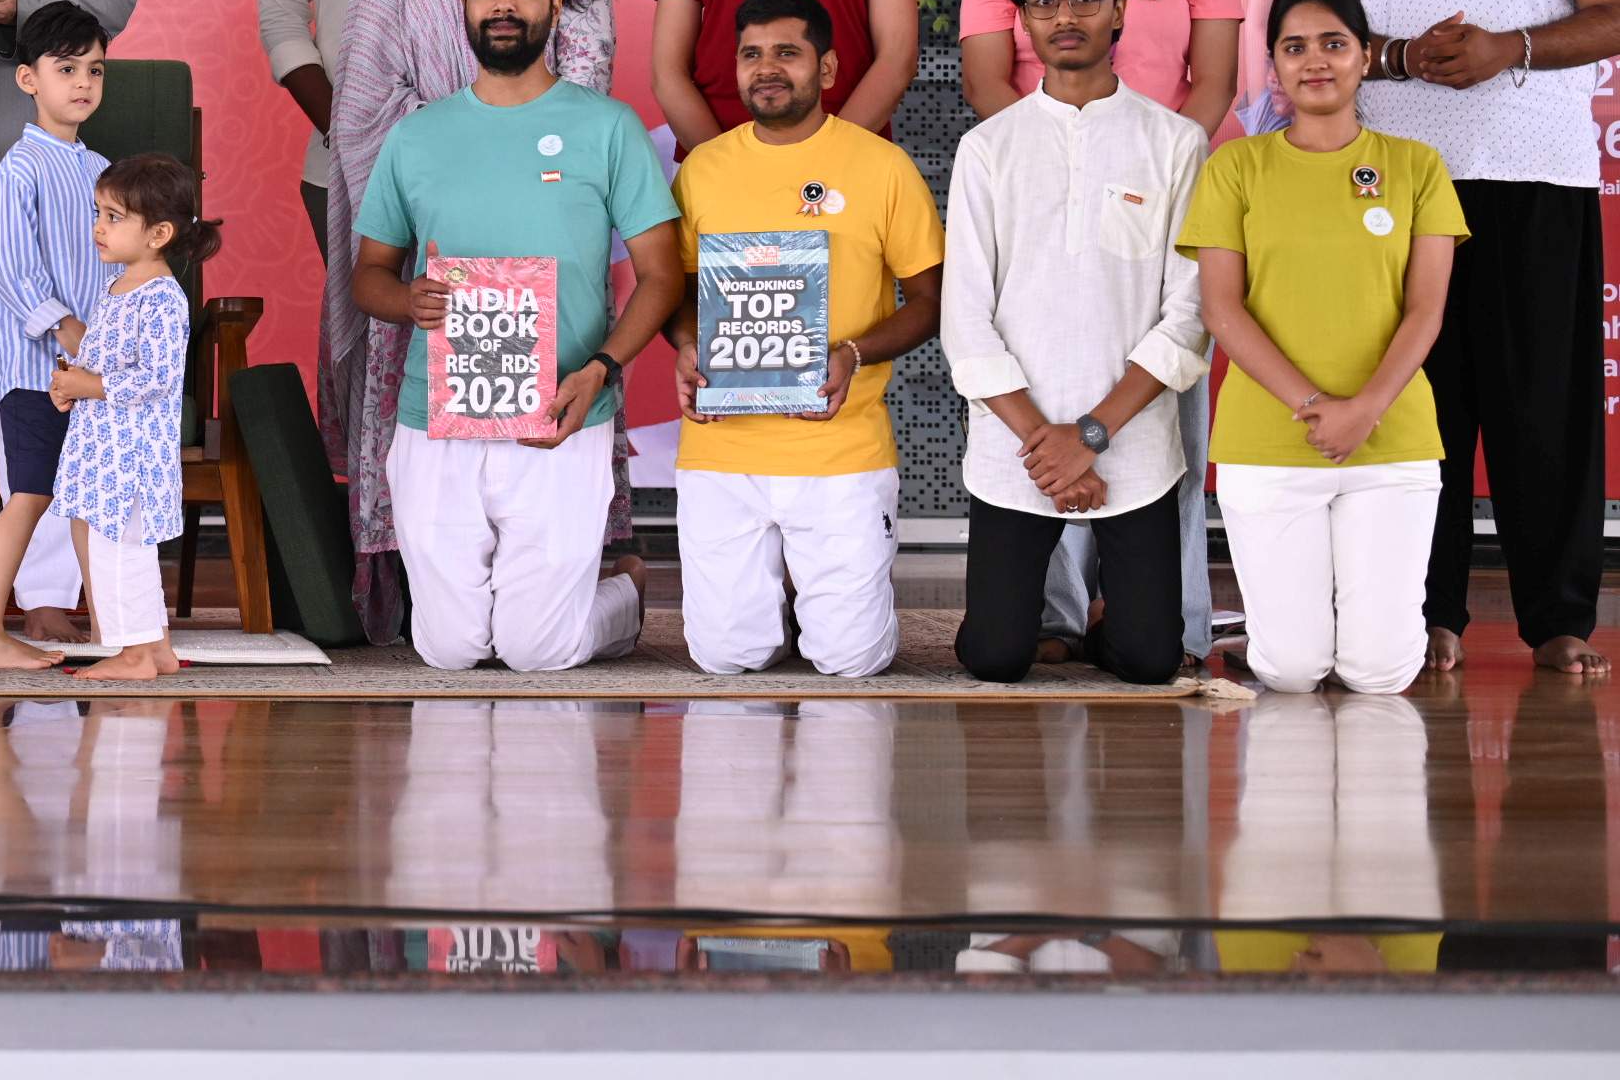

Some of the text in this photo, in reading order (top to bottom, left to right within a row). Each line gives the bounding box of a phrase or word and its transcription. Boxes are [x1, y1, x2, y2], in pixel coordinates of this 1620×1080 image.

[718, 279, 805, 293] WORLDKINGS
[446, 287, 540, 312] INDIA
[727, 292, 796, 319] TOP
[445, 312, 540, 339] BOOK
[718, 320, 804, 336] RECORDS
[479, 338, 502, 353] OF
[709, 335, 811, 369] 2026
[444, 376, 541, 414] 2026
